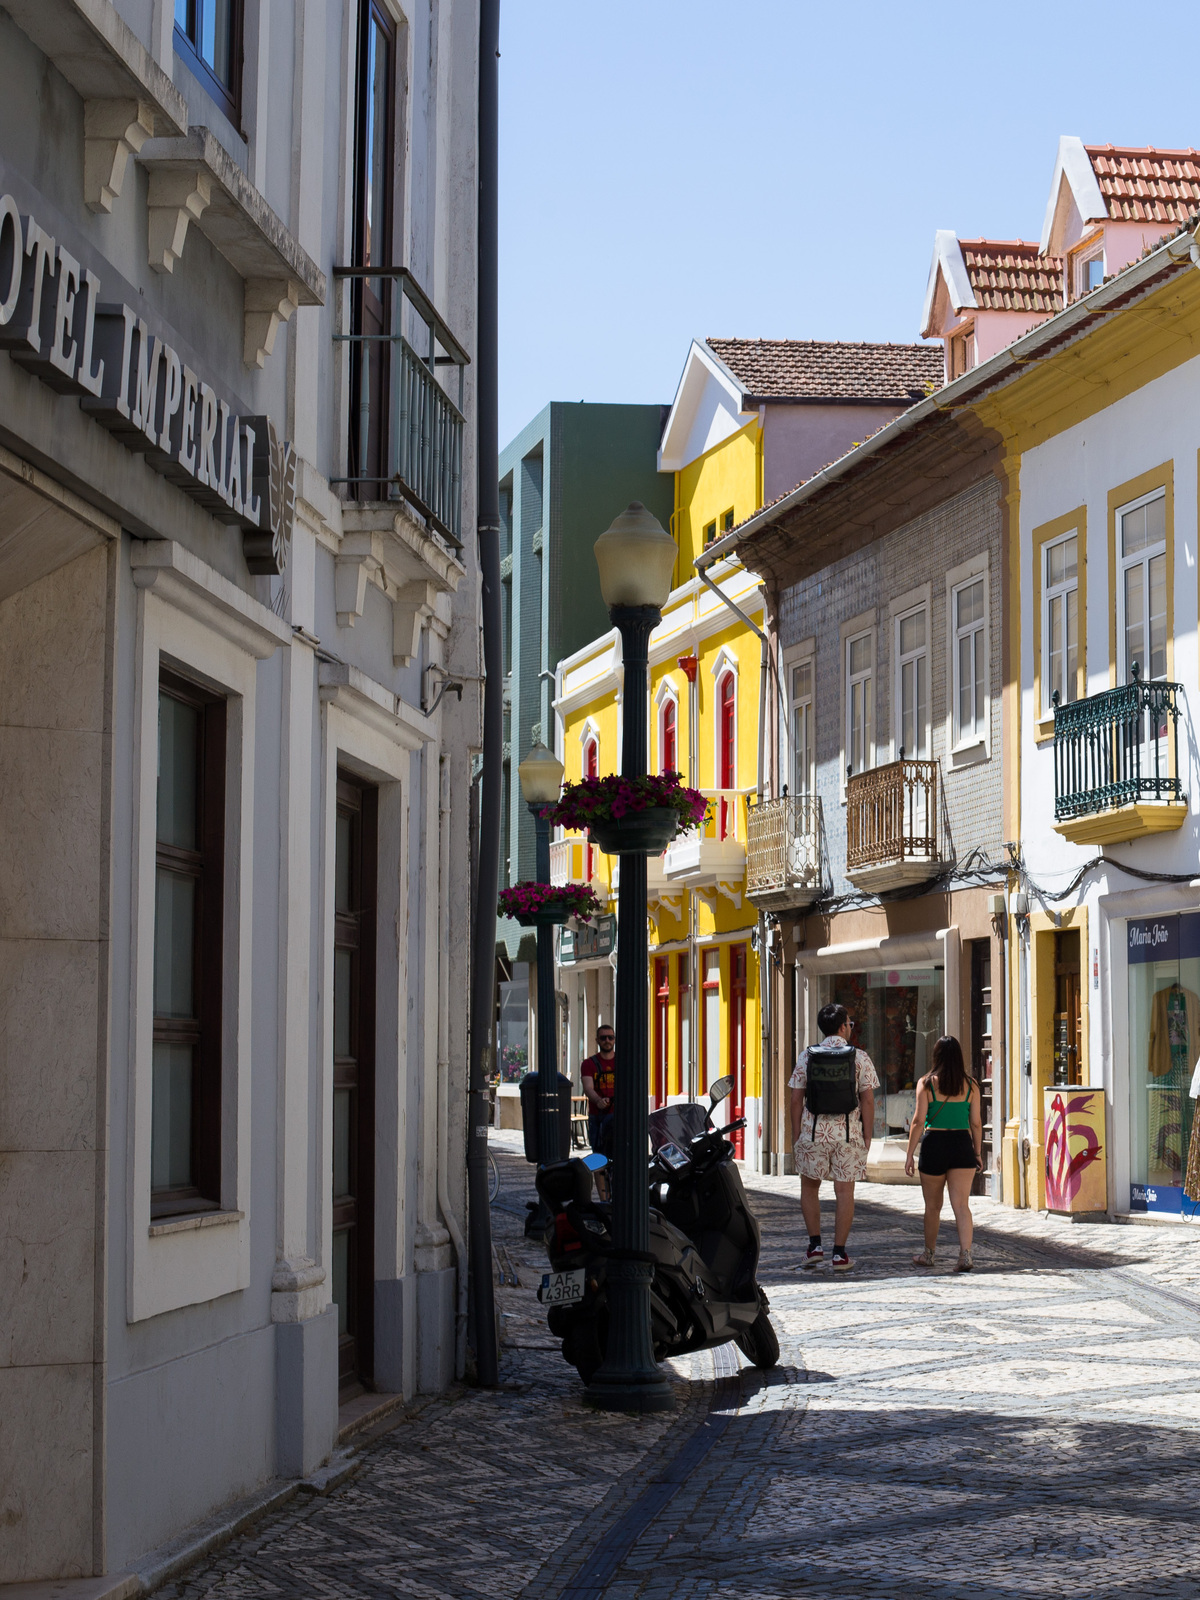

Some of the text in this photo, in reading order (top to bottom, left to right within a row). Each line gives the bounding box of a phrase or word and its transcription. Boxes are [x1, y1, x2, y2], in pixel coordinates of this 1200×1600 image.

[117, 303, 261, 527] IMPERIAL
[1129, 924, 1169, 947] Maria João
[812, 1066, 848, 1078] OAKLEY
[554, 1272, 575, 1287] AF
[546, 1284, 581, 1300] 43RR
